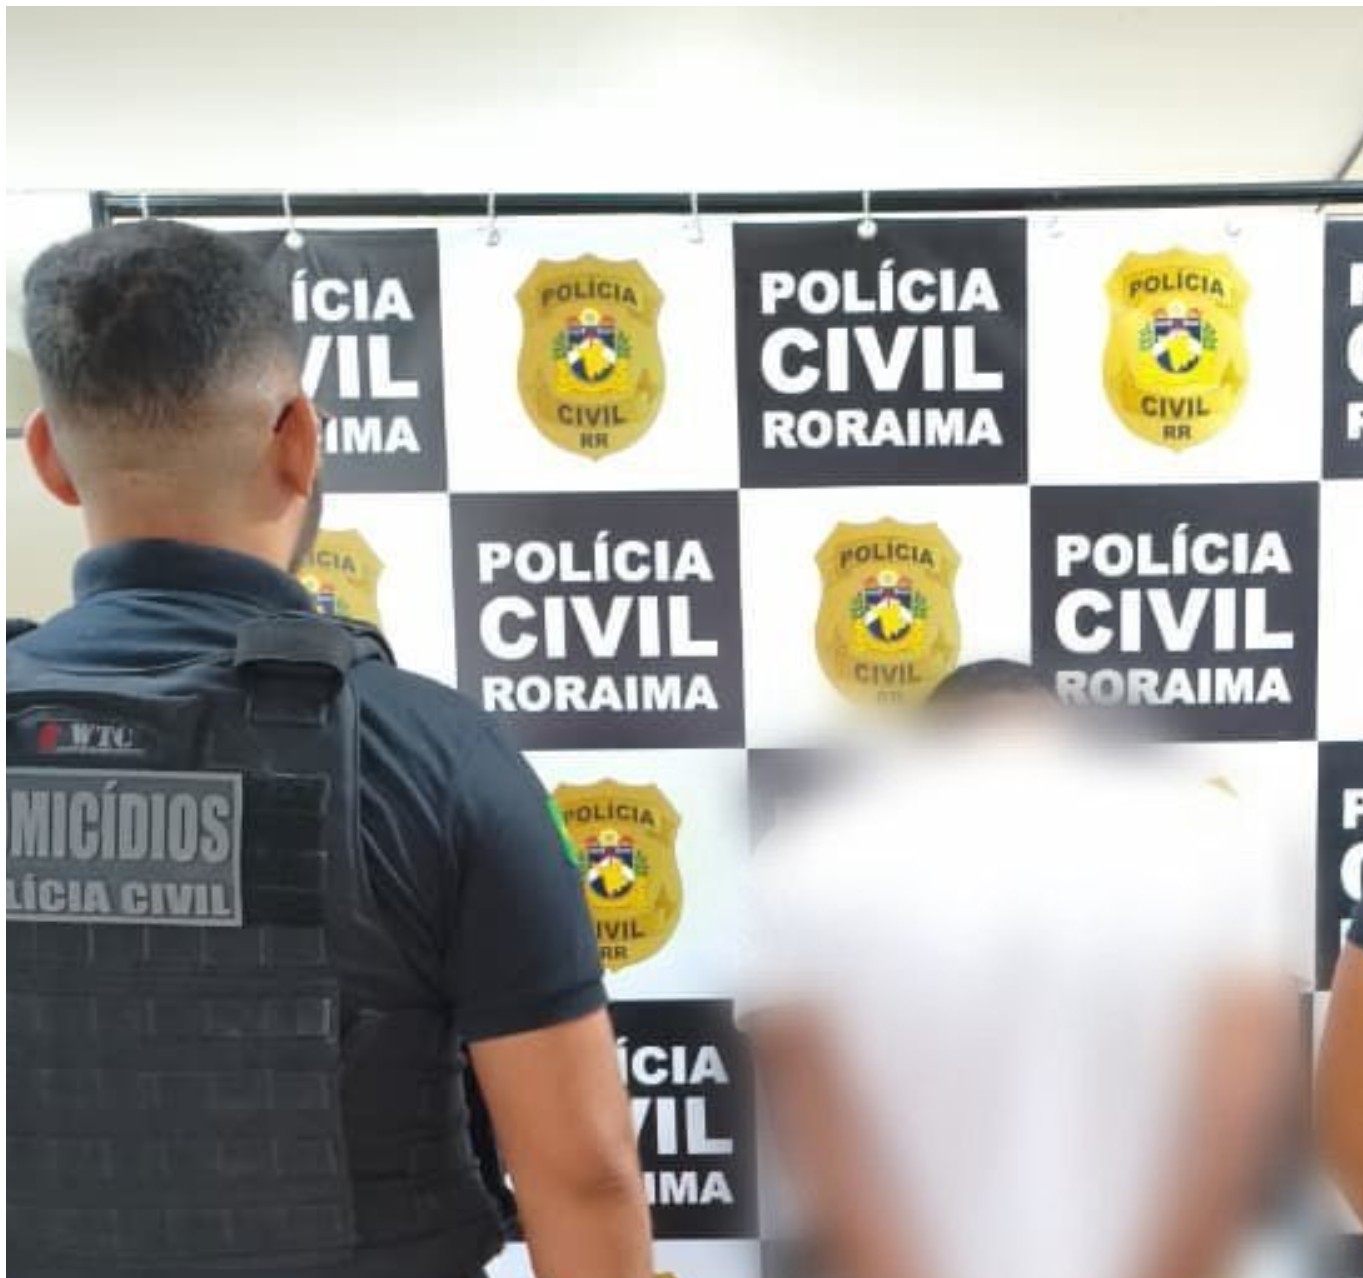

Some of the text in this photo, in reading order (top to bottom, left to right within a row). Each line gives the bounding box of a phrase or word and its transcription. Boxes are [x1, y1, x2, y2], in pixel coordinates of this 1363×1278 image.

[292, 268, 414, 321] ÍCIA
[541, 278, 638, 307] POLÍCIA
[760, 259, 1000, 314] POLÍCIA
[1129, 271, 1224, 299] POLÍCIA
[760, 326, 1003, 394] CIVIL
[557, 404, 627, 427] CIVIL
[1140, 395, 1211, 418] CIVIL
[762, 407, 1003, 448] RORAIMA
[1163, 425, 1192, 440] RR
[478, 530, 714, 583] POLÍCIA
[839, 539, 936, 569] POLÍCIA
[1056, 522, 1293, 578] POLÍCIA
[478, 595, 718, 659] CIVIL
[1055, 588, 1295, 653] CIVIL
[482, 675, 719, 713] RORAIMA
[854, 662, 923, 686] CIVIL
[1055, 668, 1293, 706] RORAIMA
[10, 779, 232, 864] MICÍDIOS
[6, 874, 232, 916] LÍCIA CIVIL
[597, 919, 646, 940] IVIL
[616, 1036, 730, 1085] ÍCIA
